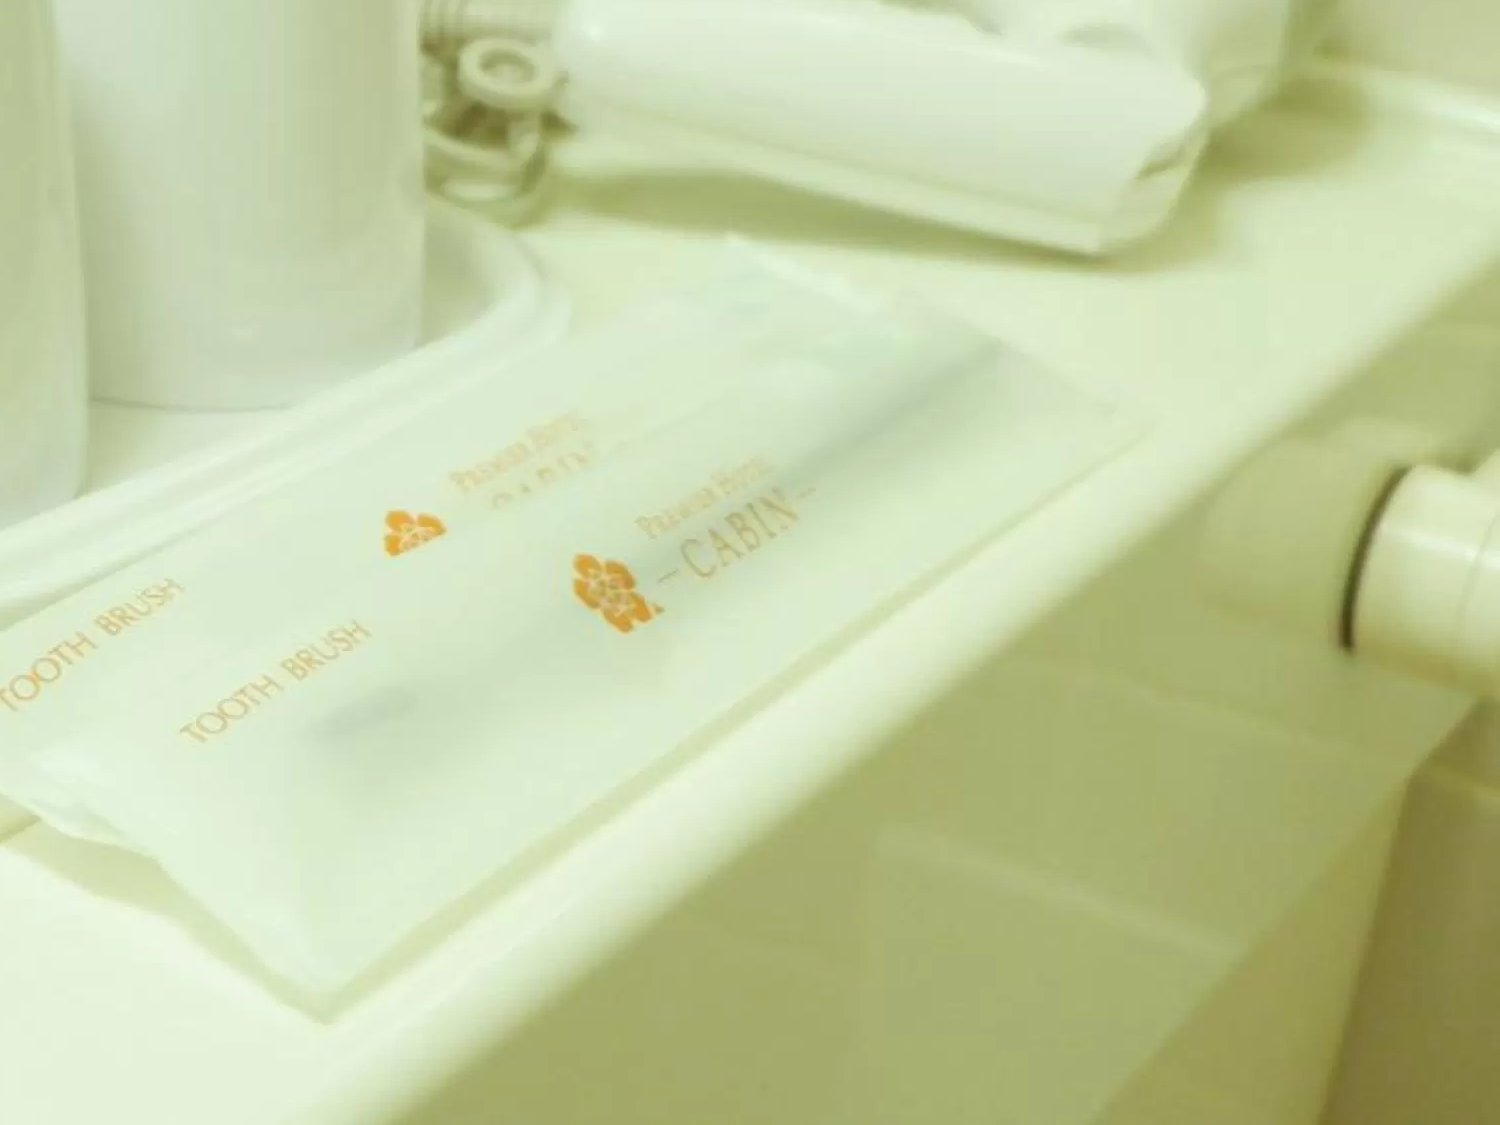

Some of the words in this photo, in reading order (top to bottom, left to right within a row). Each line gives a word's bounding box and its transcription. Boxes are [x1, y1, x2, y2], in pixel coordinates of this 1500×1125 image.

[93, 576, 186, 638] BRUSH
[178, 673, 285, 745] TOOTH
[279, 618, 373, 683] BRUSH
